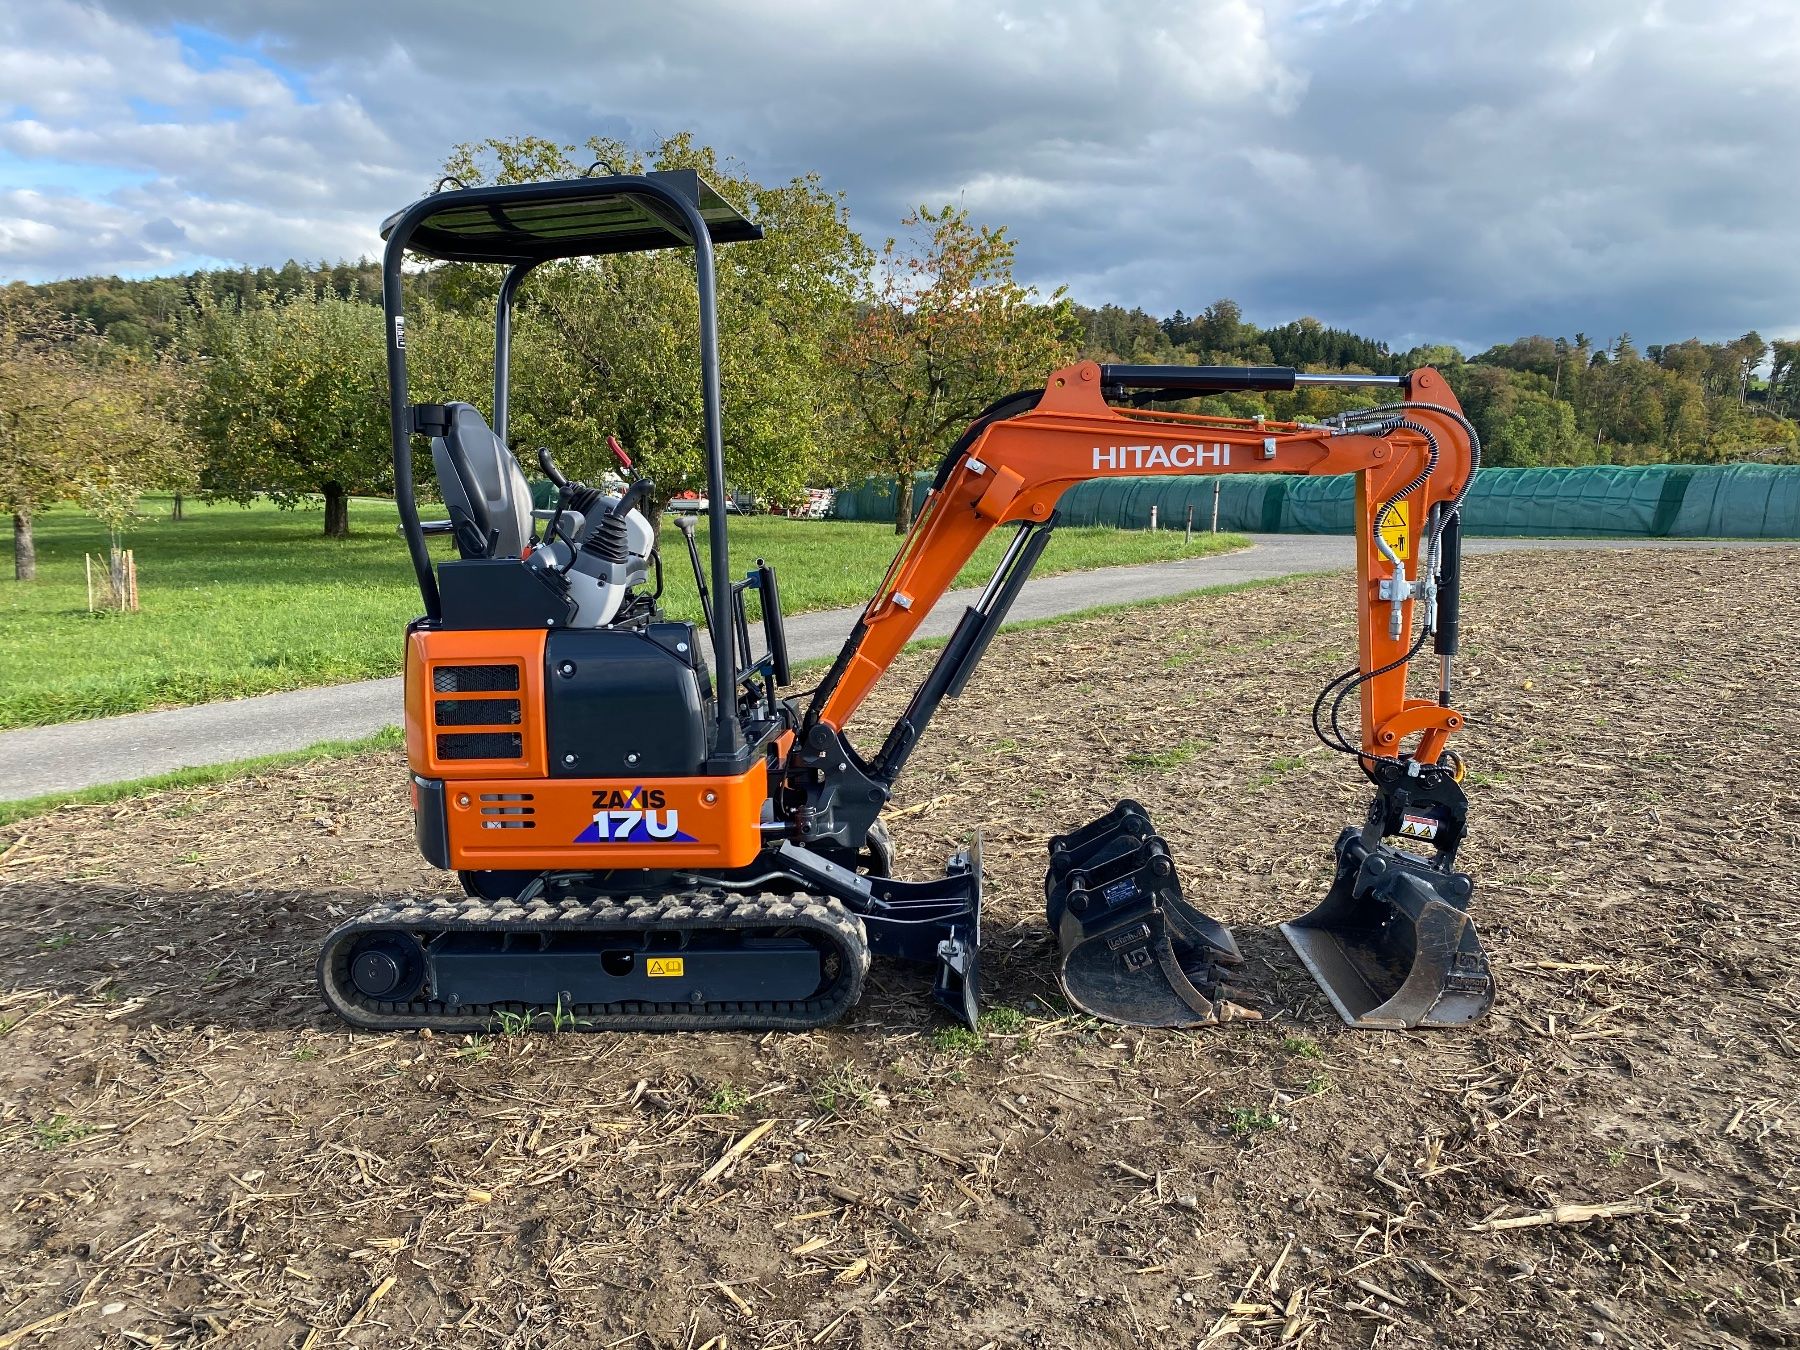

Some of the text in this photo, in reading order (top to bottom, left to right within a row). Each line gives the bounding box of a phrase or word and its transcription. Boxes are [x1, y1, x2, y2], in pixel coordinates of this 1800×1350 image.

[1093, 444, 1230, 469] HITACHI
[592, 786, 665, 809] ZAXIS
[593, 810, 678, 840] 17U
